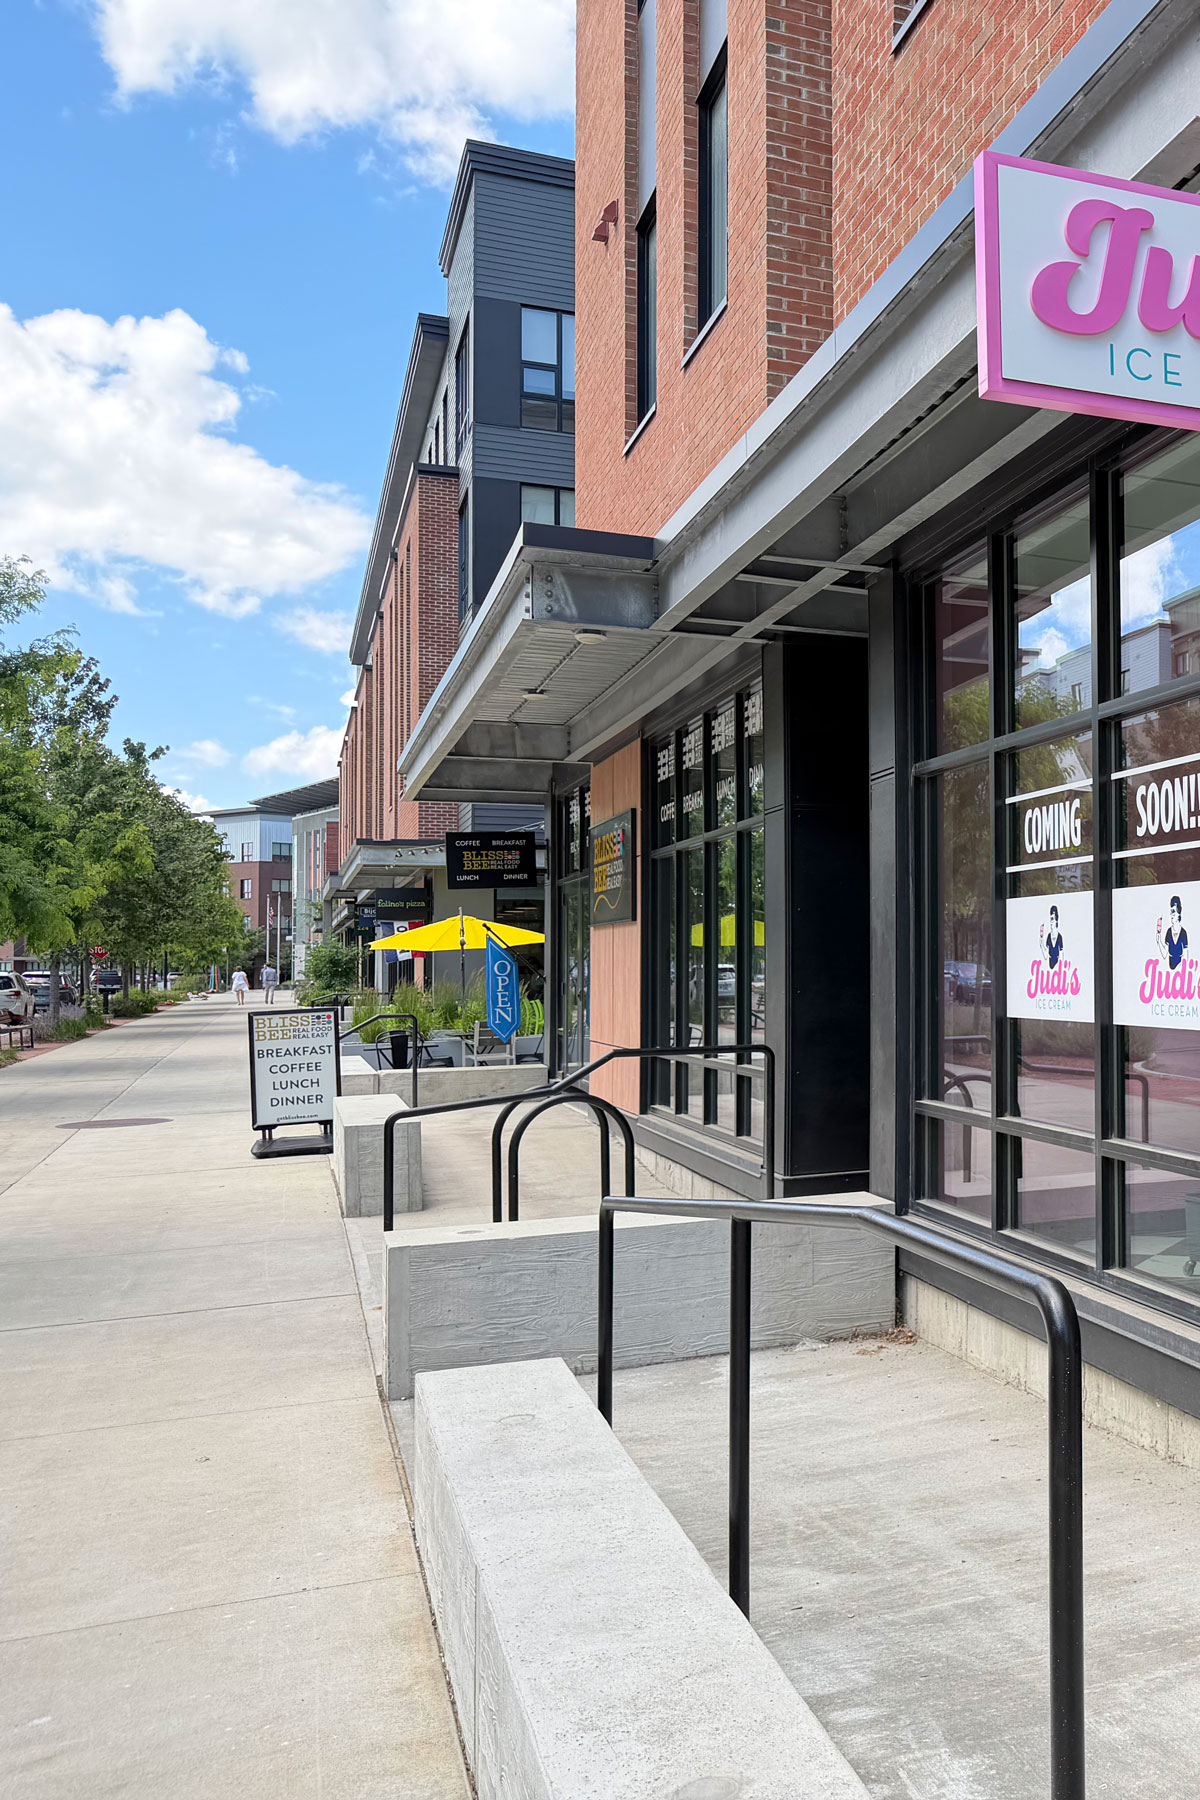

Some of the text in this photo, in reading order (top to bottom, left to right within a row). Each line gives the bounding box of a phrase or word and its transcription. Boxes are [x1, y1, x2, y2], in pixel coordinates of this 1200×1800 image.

[1109, 343, 1182, 387] ICE
[716, 775, 736, 801] LUNCH
[660, 801, 675, 823] COFFE
[1024, 798, 1082, 854] COMING
[594, 831, 614, 865] BLISS
[463, 850, 504, 861] BLISS
[463, 861, 490, 871] BEE
[594, 864, 608, 893] BEE
[378, 899, 405, 908] folino's
[89, 946, 107, 954] STO
[1027, 959, 1081, 999] Judi's
[494, 960, 513, 1024] OPEN
[1035, 999, 1071, 1011] ICE CREAM
[1151, 1004, 1199, 1018] ICE CREAM
[255, 1015, 310, 1029] BLISS
[255, 1029, 292, 1041] BEE
[257, 1045, 333, 1059] BREAKFAST
[269, 1062, 322, 1074] COFFEE
[273, 1078, 320, 1091] LUNCH
[270, 1094, 324, 1107] DINNER
